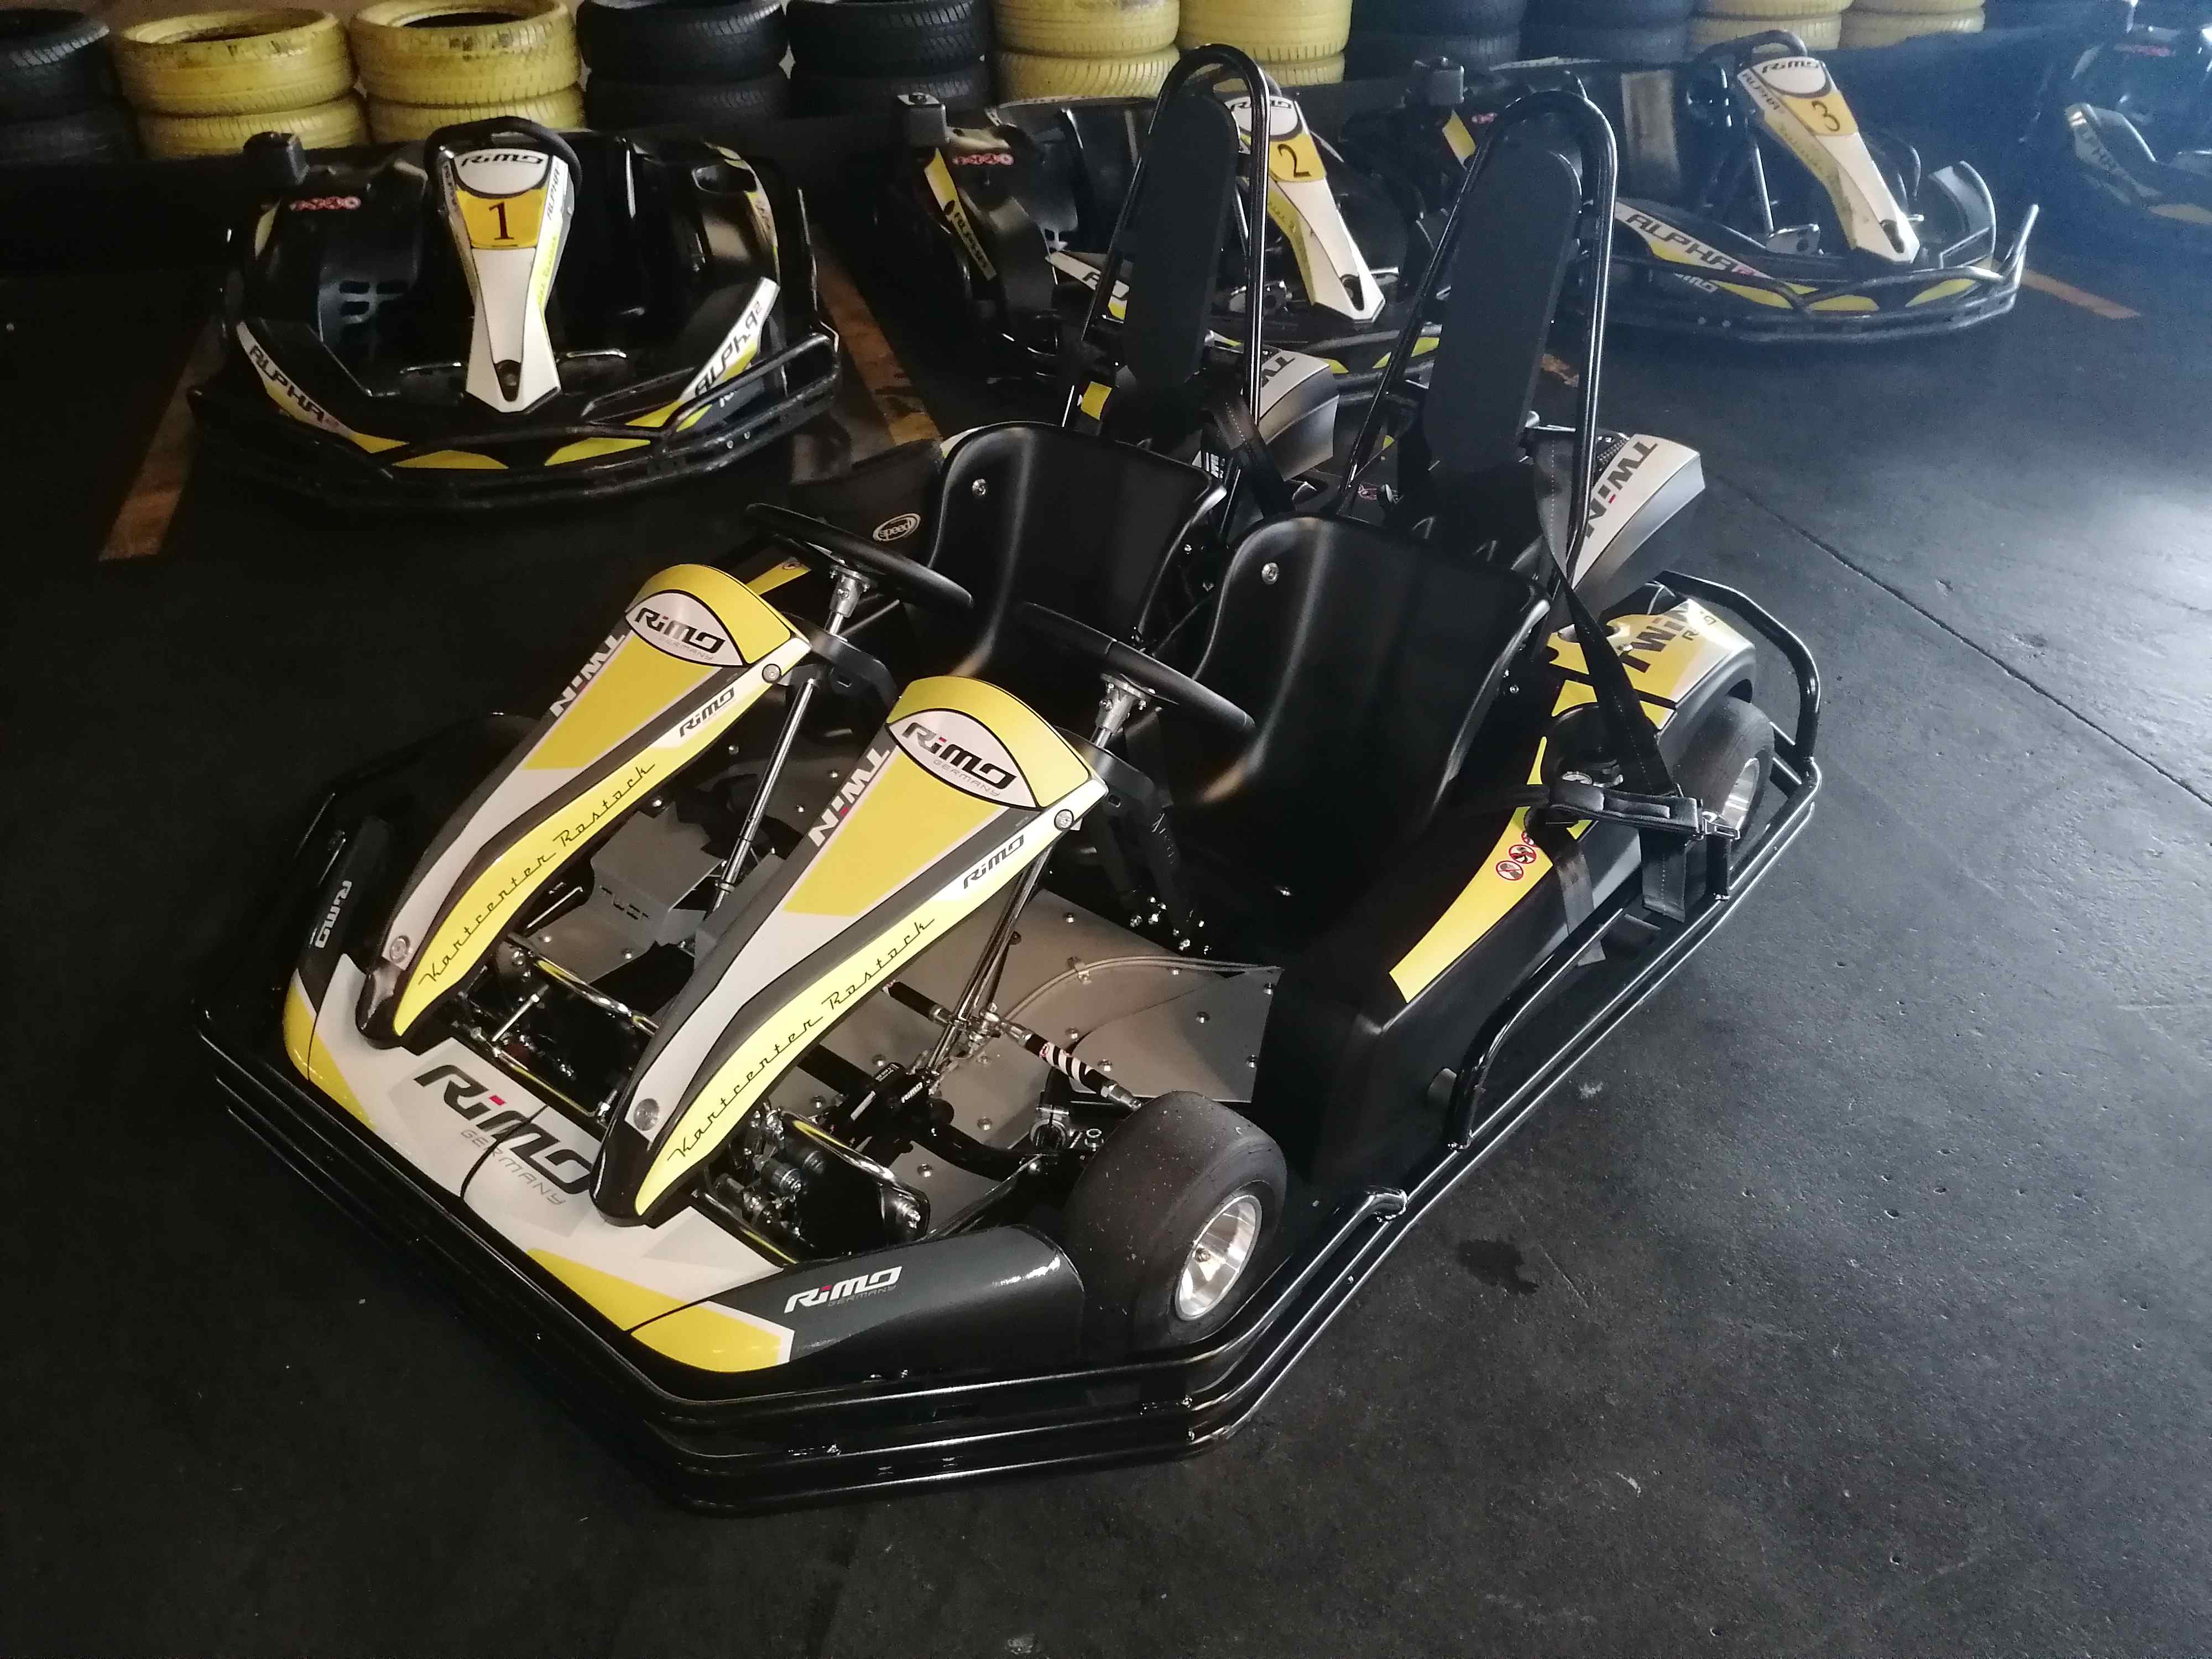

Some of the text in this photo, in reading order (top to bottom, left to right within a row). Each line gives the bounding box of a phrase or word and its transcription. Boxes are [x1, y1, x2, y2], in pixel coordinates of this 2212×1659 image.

[1811, 100, 1841, 132] 3
[1277, 144, 1312, 178] 2
[489, 202, 514, 241] 1
[933, 759, 1001, 797] GERMANY
[418, 764, 656, 985] Kartcenter Rostock
[667, 918, 936, 1161] Kartcenter Rostock
[460, 1129, 567, 1206] GERMANY
